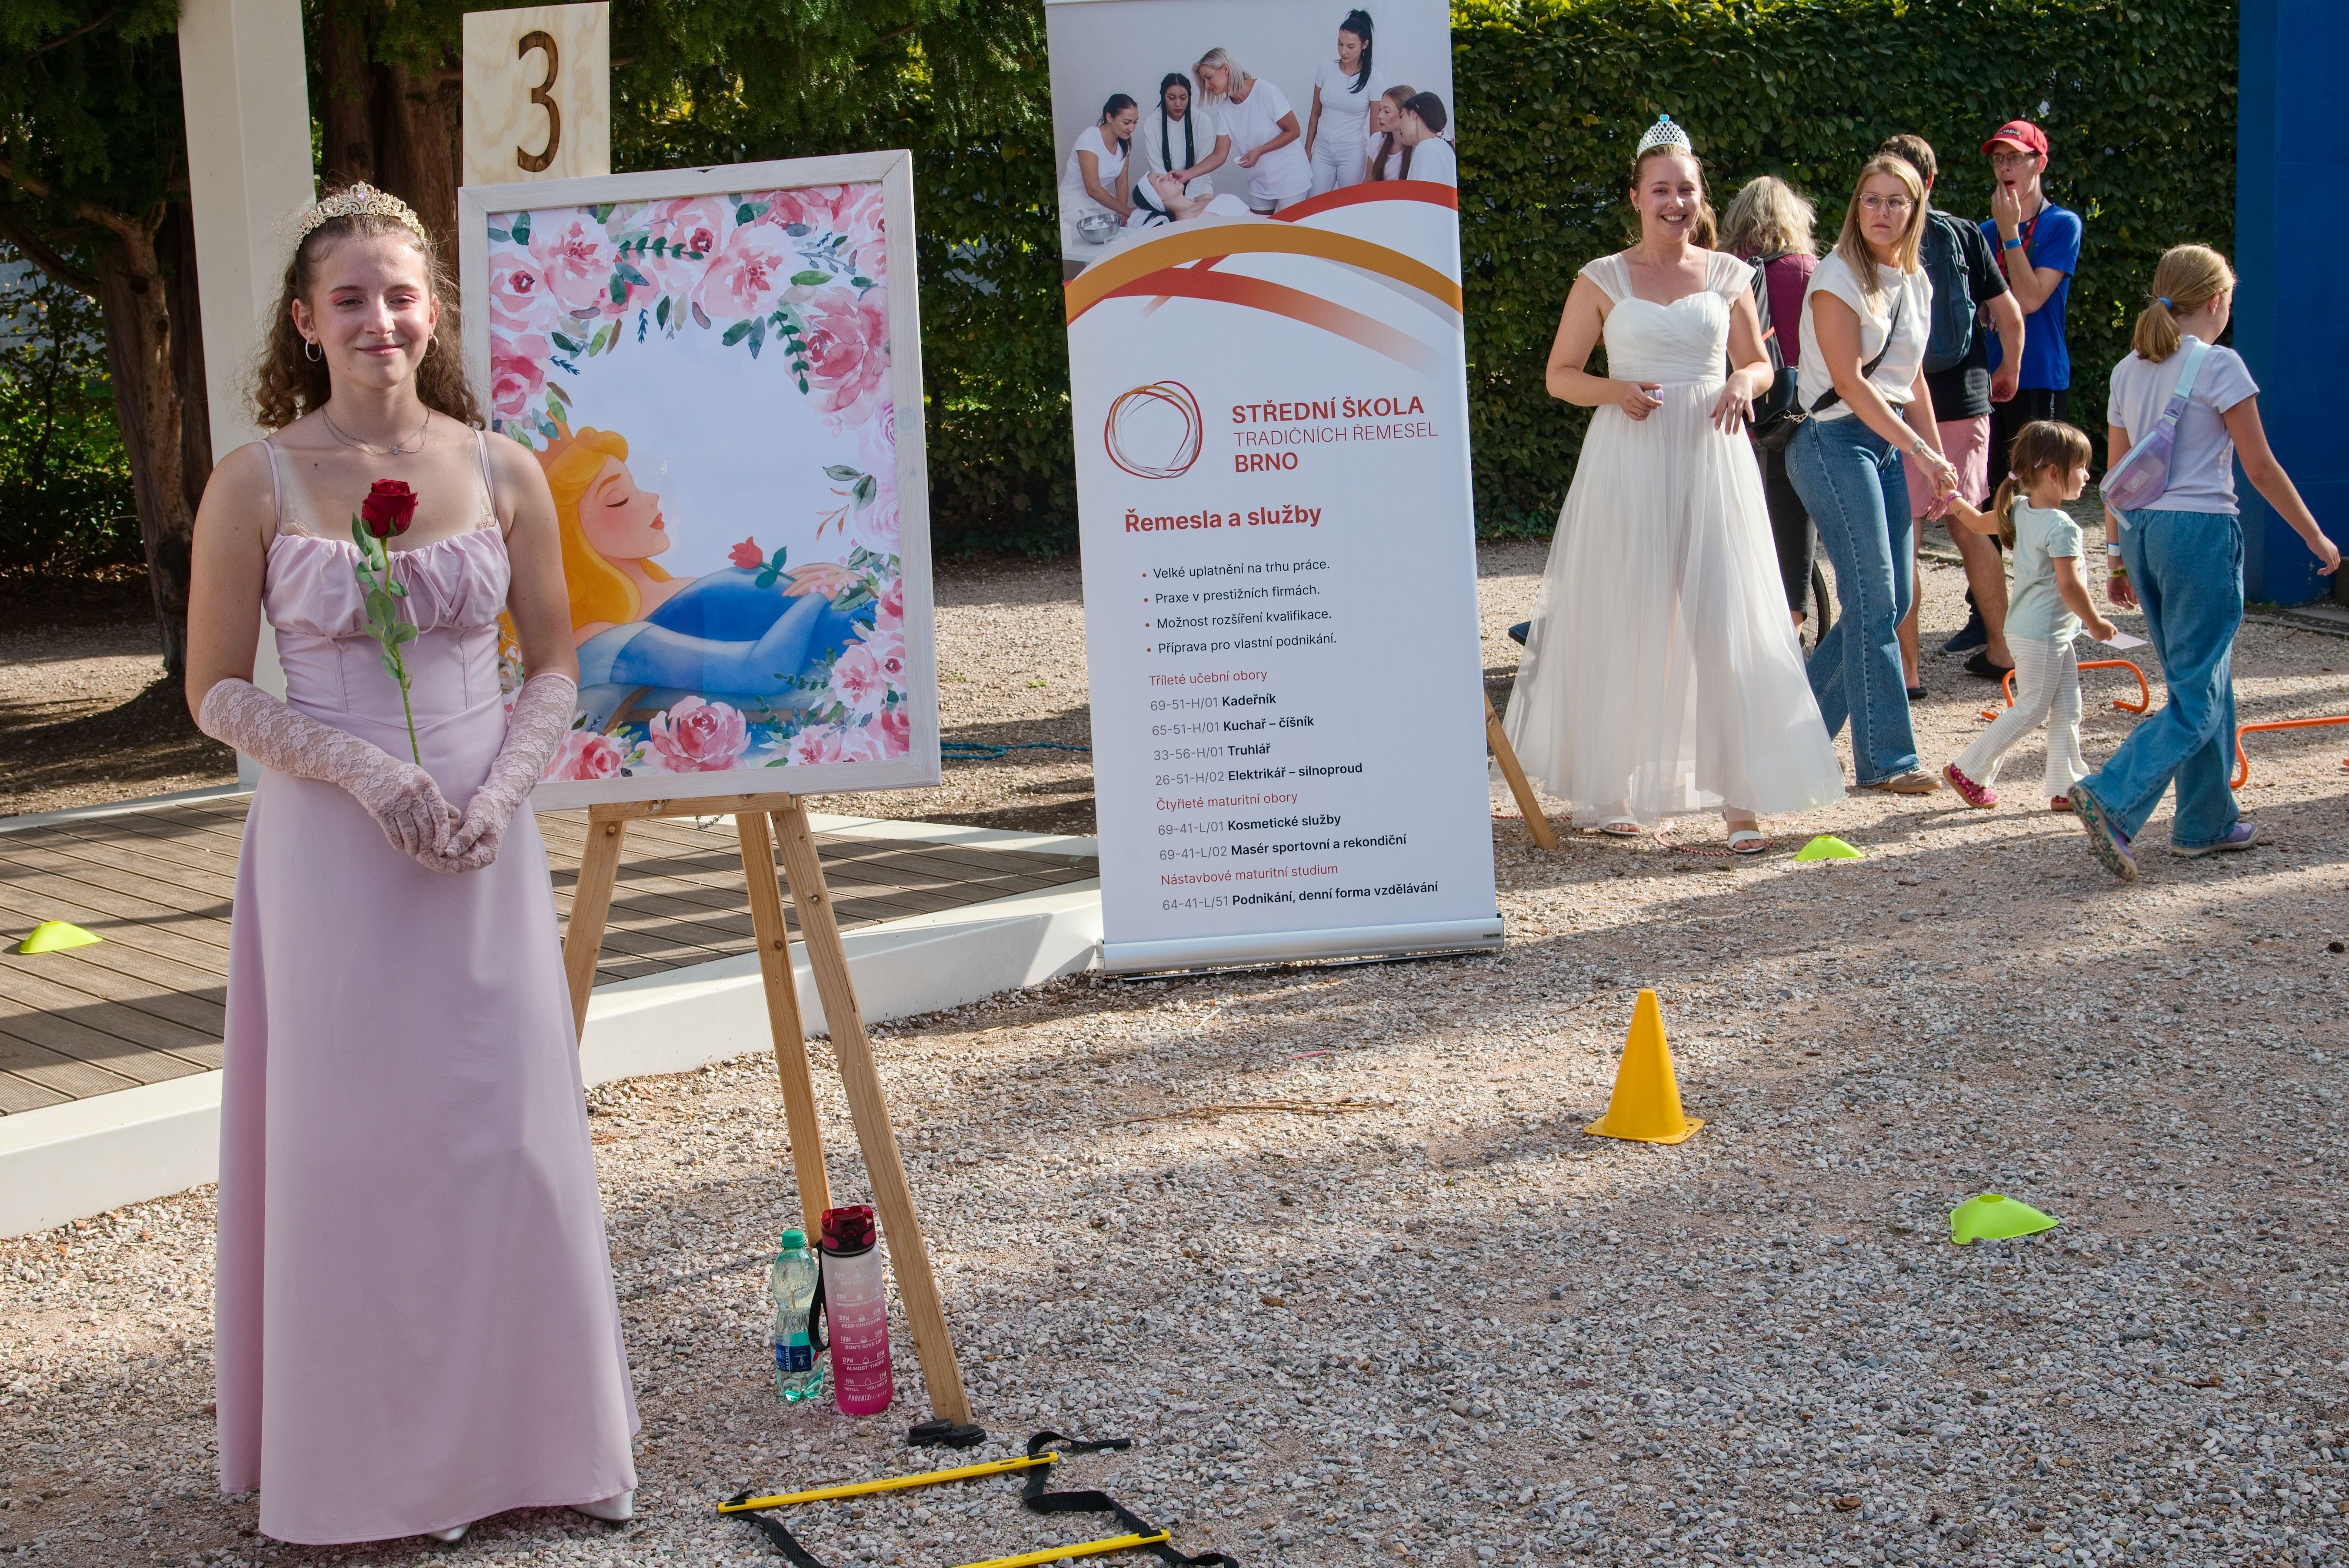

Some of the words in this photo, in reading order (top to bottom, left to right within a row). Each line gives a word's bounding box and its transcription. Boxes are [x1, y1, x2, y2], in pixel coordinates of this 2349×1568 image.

[517, 31, 560, 172] 3
[1232, 396, 1336, 424] STŘEDNÍ
[1342, 396, 1425, 418] ŠKOLA
[1233, 425, 1347, 447] TRADIČNÍCH
[1353, 422, 1439, 441] ŘEMESEL
[1235, 452, 1298, 473] BRNO
[1125, 508, 1222, 533] Řemesla
[1228, 513, 1241, 527] a
[1247, 504, 1322, 527] služby
[1153, 566, 1186, 579] Velké
[1189, 562, 1244, 579] uplatnění
[1247, 565, 1262, 573] na
[1265, 561, 1289, 573] trhu
[1293, 559, 1330, 573] práce.
[1155, 593, 1189, 604] Praxe
[1192, 593, 1199, 602] v
[1203, 587, 1269, 604] prestižních
[1271, 584, 1320, 597] firmách.
[1157, 616, 1209, 629] Možnost
[1212, 611, 1263, 626] rozšíření
[1266, 609, 1332, 623] kvalifikace.
[1158, 642, 1207, 656] Příprava
[1211, 641, 1230, 653] pro
[1233, 636, 1273, 649] vlastní
[1276, 632, 1337, 649] podnikání.
[1149, 673, 1186, 686] Tříleté
[1189, 670, 1229, 684] učební
[1233, 670, 1267, 682] obory
[1150, 697, 1218, 711] 69-51-H/01
[1222, 692, 1276, 707] Kadeřník
[1152, 722, 1219, 736] 65-51-H/01
[1223, 718, 1266, 732] Kuchař
[1278, 715, 1315, 728] číšník
[1154, 746, 1223, 761] 33-56-H/01
[1227, 742, 1271, 756] Truhlář
[1155, 771, 1224, 786] 26-51-H/02
[1228, 766, 1286, 781] Elektrikář
[1298, 762, 1363, 777] silnoproud
[1156, 796, 1204, 812] Čtyřleté
[1208, 793, 1260, 807] maturitní
[1263, 792, 1298, 805] obory
[1158, 821, 1223, 836] 69-41-L/01
[1227, 815, 1299, 831] Kosmetické
[1301, 814, 1341, 827] služby
[1160, 846, 1227, 860] 69-41-L/02
[1231, 842, 1269, 856] Masér
[1272, 838, 1330, 855] sportovní
[1333, 840, 1340, 849] a
[1343, 833, 1407, 849] rekondiční
[1161, 870, 1232, 886] Nástavbové
[1235, 866, 1288, 880] maturitní
[1291, 864, 1338, 877] studium
[1163, 896, 1228, 911] 64-41-L/51
[1232, 890, 1296, 906] Podnikání,
[1299, 888, 1333, 901] denní
[1335, 887, 1371, 899] forma
[1373, 880, 1438, 896] vzdělávání
[856, 1316, 881, 1328] CHUGGING
[870, 1359, 884, 1368] THERE
